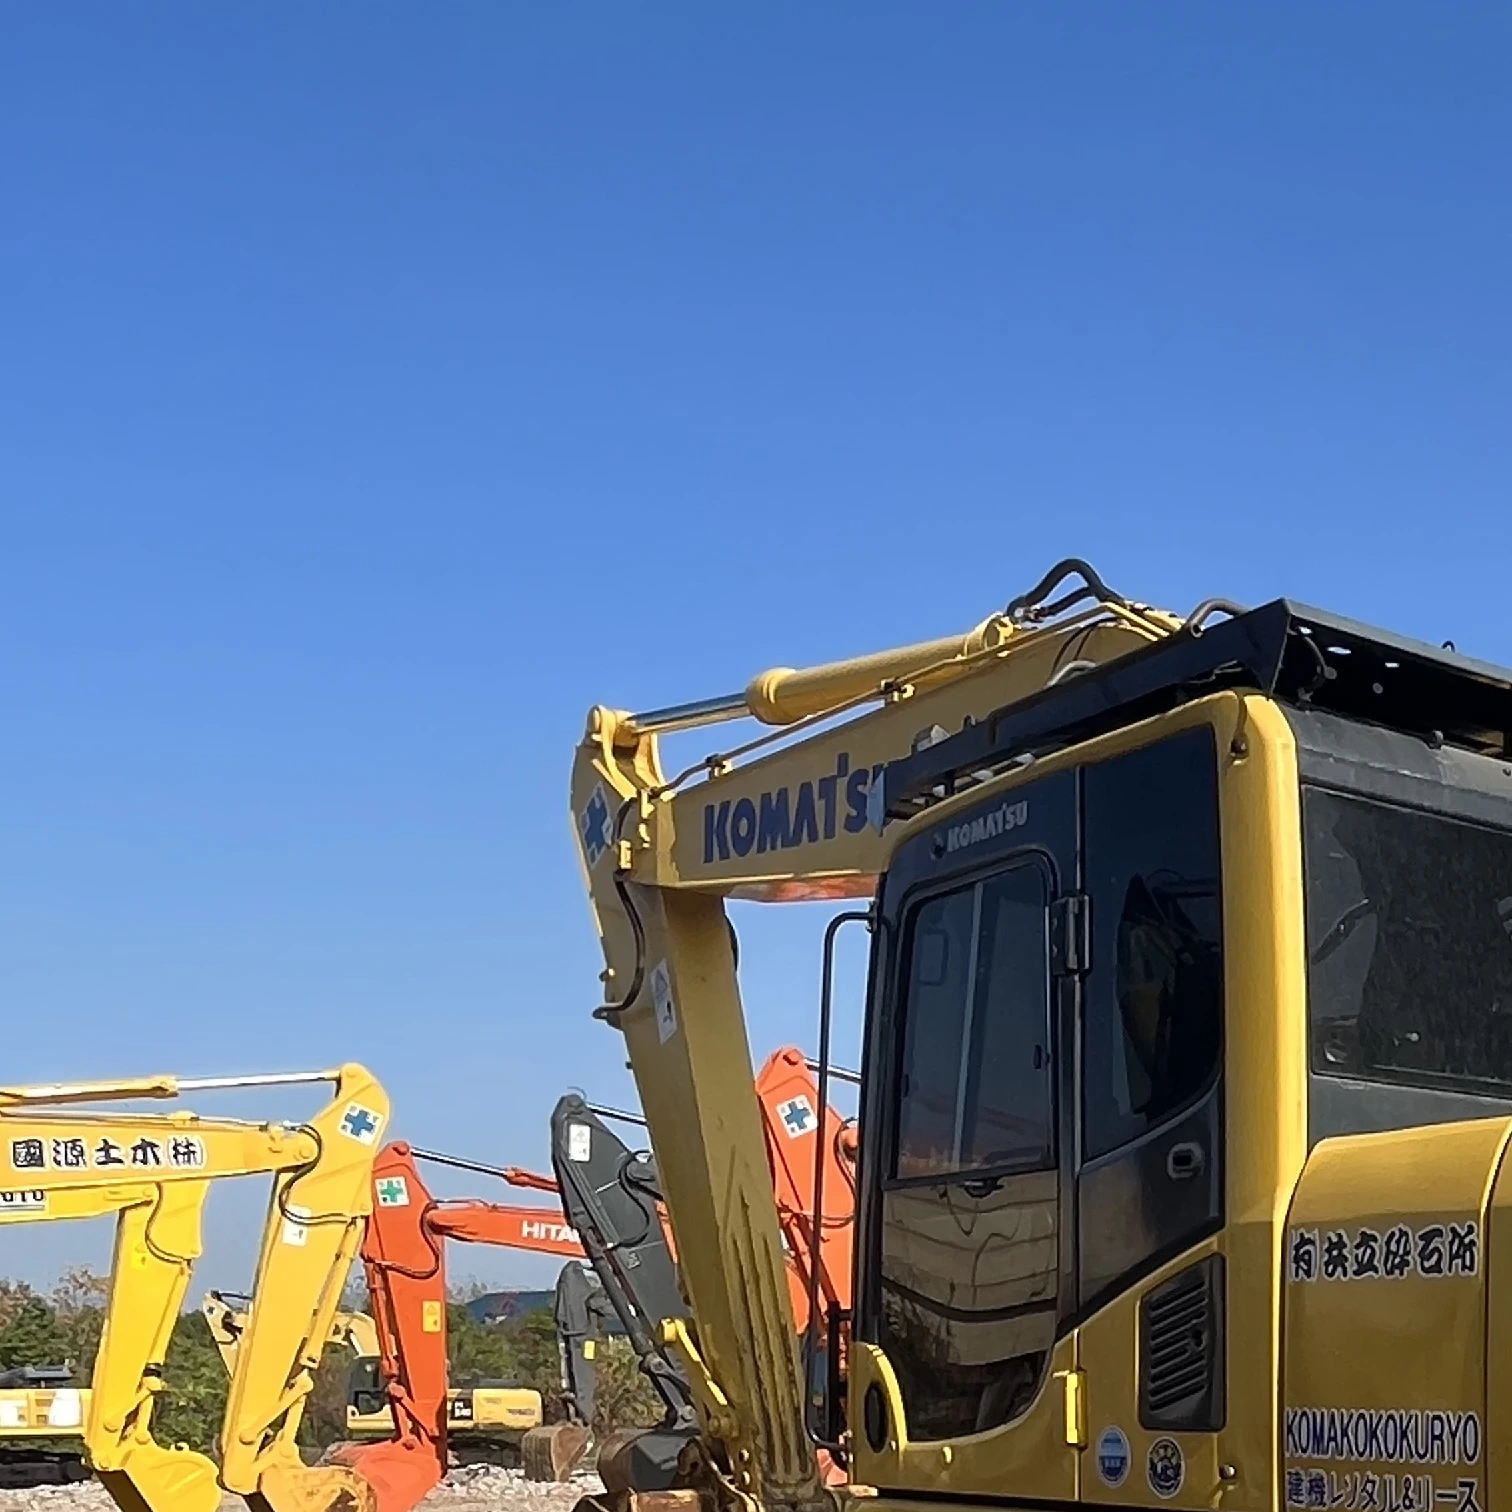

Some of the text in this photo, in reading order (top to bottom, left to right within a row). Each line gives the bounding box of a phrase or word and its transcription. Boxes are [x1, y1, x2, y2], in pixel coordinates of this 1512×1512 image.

[703, 752, 883, 864] KOMATS
[946, 800, 1028, 852] KOMATSU
[1286, 1409, 1480, 1463] KOMAKOKOKURYO
